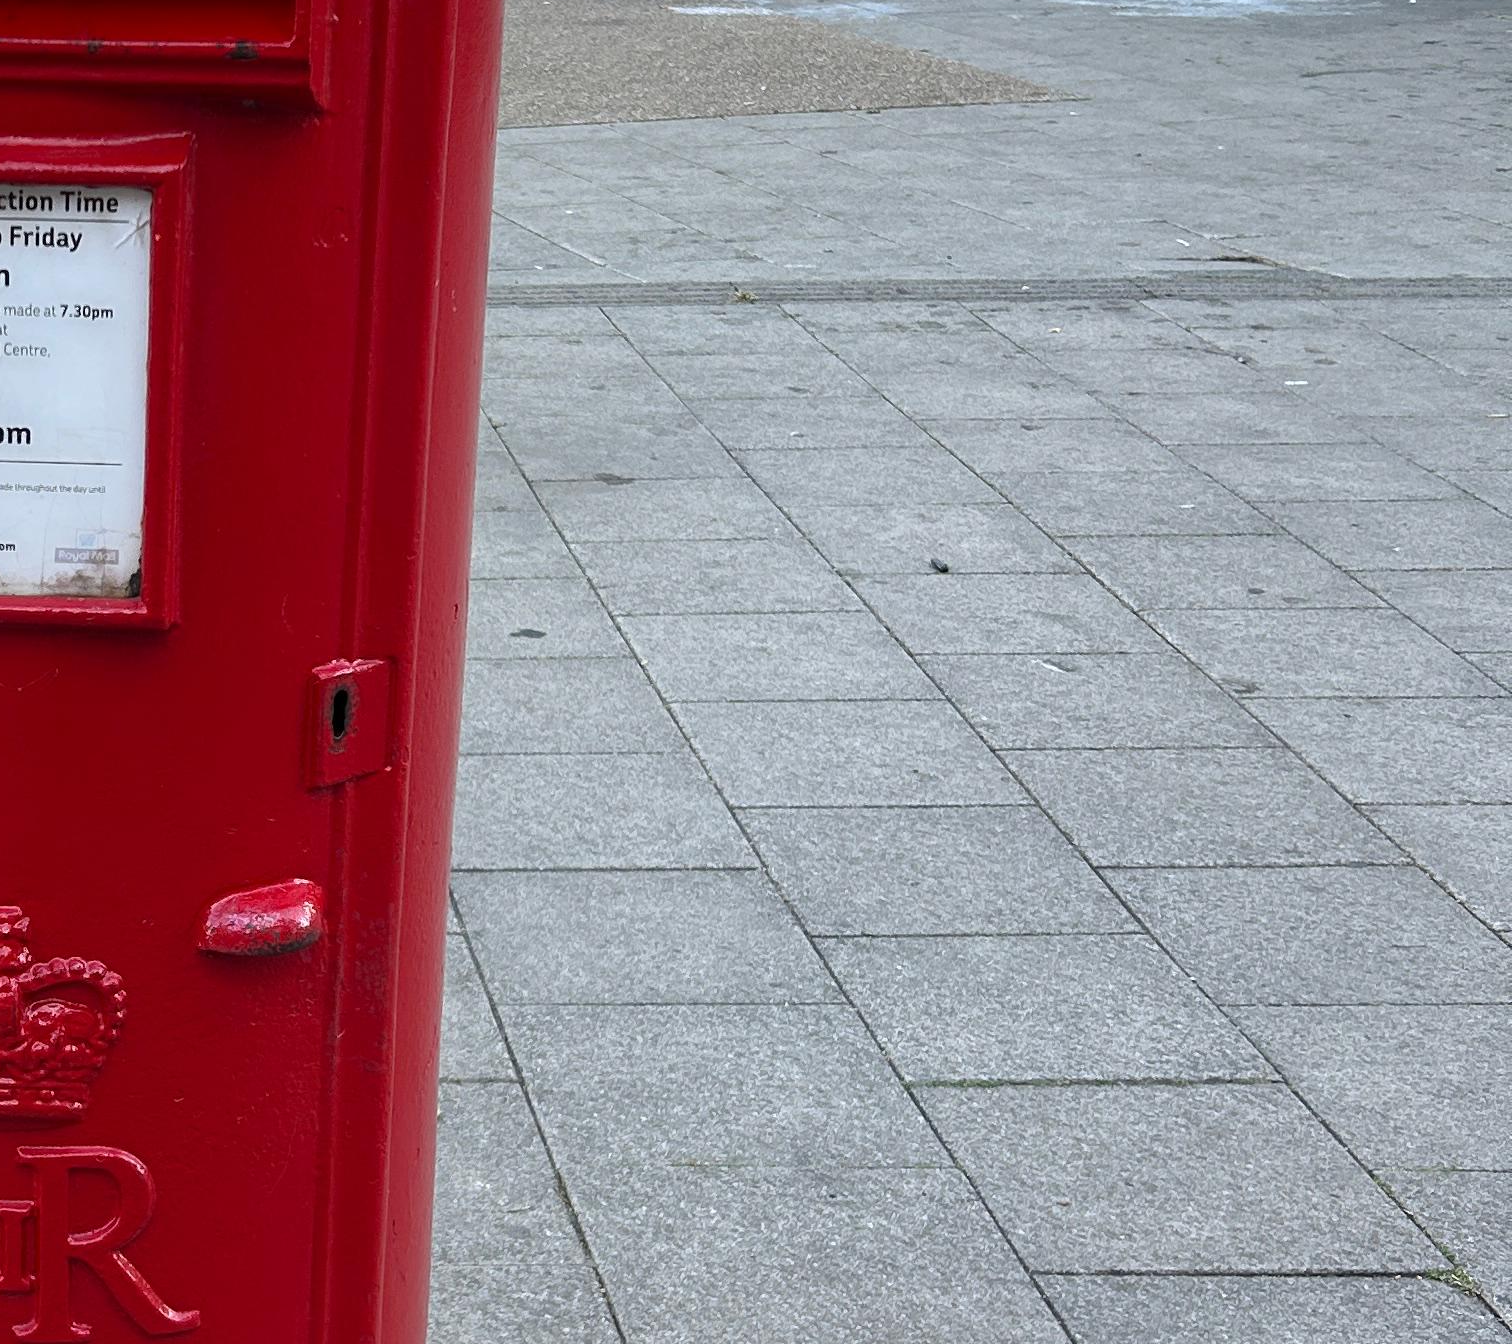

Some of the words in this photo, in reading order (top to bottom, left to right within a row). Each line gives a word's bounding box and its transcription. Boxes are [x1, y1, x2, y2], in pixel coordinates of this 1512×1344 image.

[61, 191, 119, 213] Time
[10, 226, 82, 252] Friday
[4, 304, 40, 317] made
[43, 306, 56, 317] at
[60, 305, 113, 320] 7.30pm
[4, 343, 50, 358] Centre,
[15, 483, 57, 494] throughout
[60, 485, 72, 493] the
[74, 486, 87, 494] day
[88, 485, 106, 493] until
[58, 550, 88, 563] Royal
